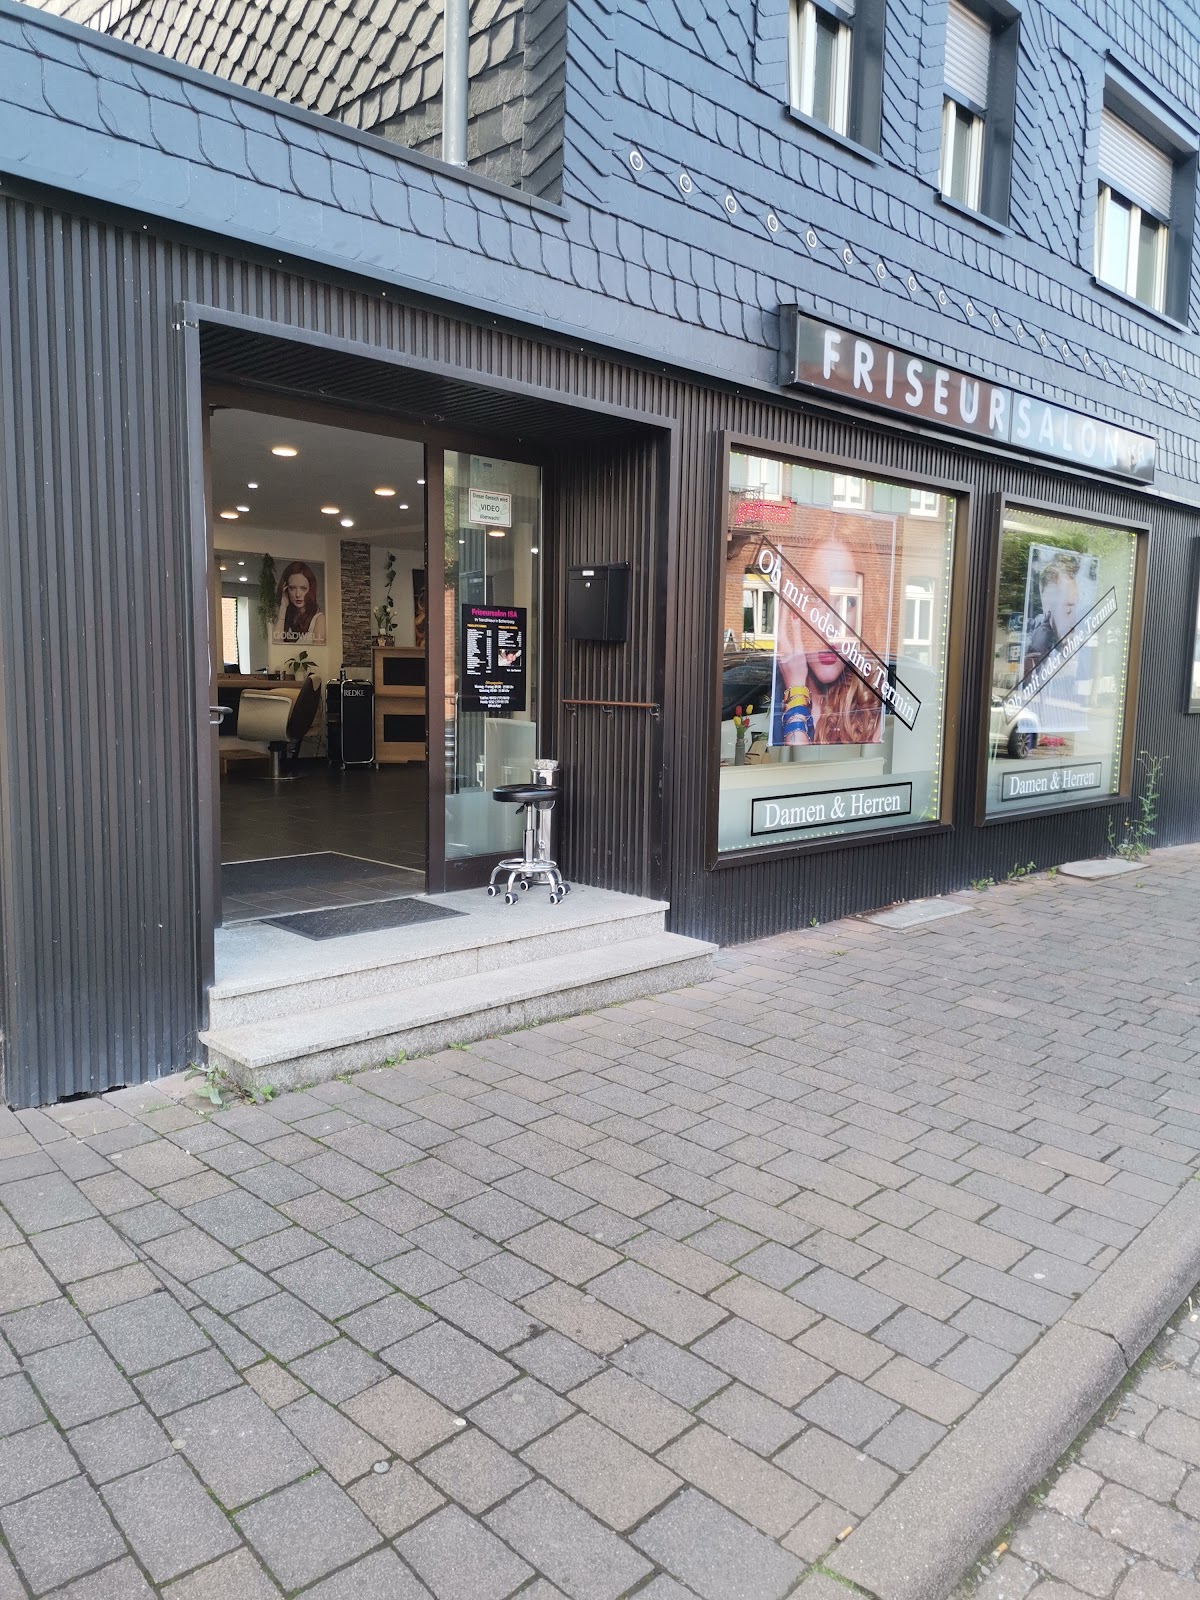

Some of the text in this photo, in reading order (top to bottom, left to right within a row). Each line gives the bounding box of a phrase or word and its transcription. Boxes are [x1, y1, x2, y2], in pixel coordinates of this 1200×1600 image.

[480, 503, 500, 513] VIDEO
[471, 607, 518, 618] Friseursalon ISA
[758, 549, 915, 722] Ob mit oder ohne Termin
[1022, 674, 1041, 699] mit
[1041, 652, 1063, 681] oder
[1062, 630, 1085, 658] ohne
[1084, 597, 1117, 634] Termin
[1009, 770, 1095, 796] Damen & Herren
[764, 793, 901, 828] Damen & Herren
